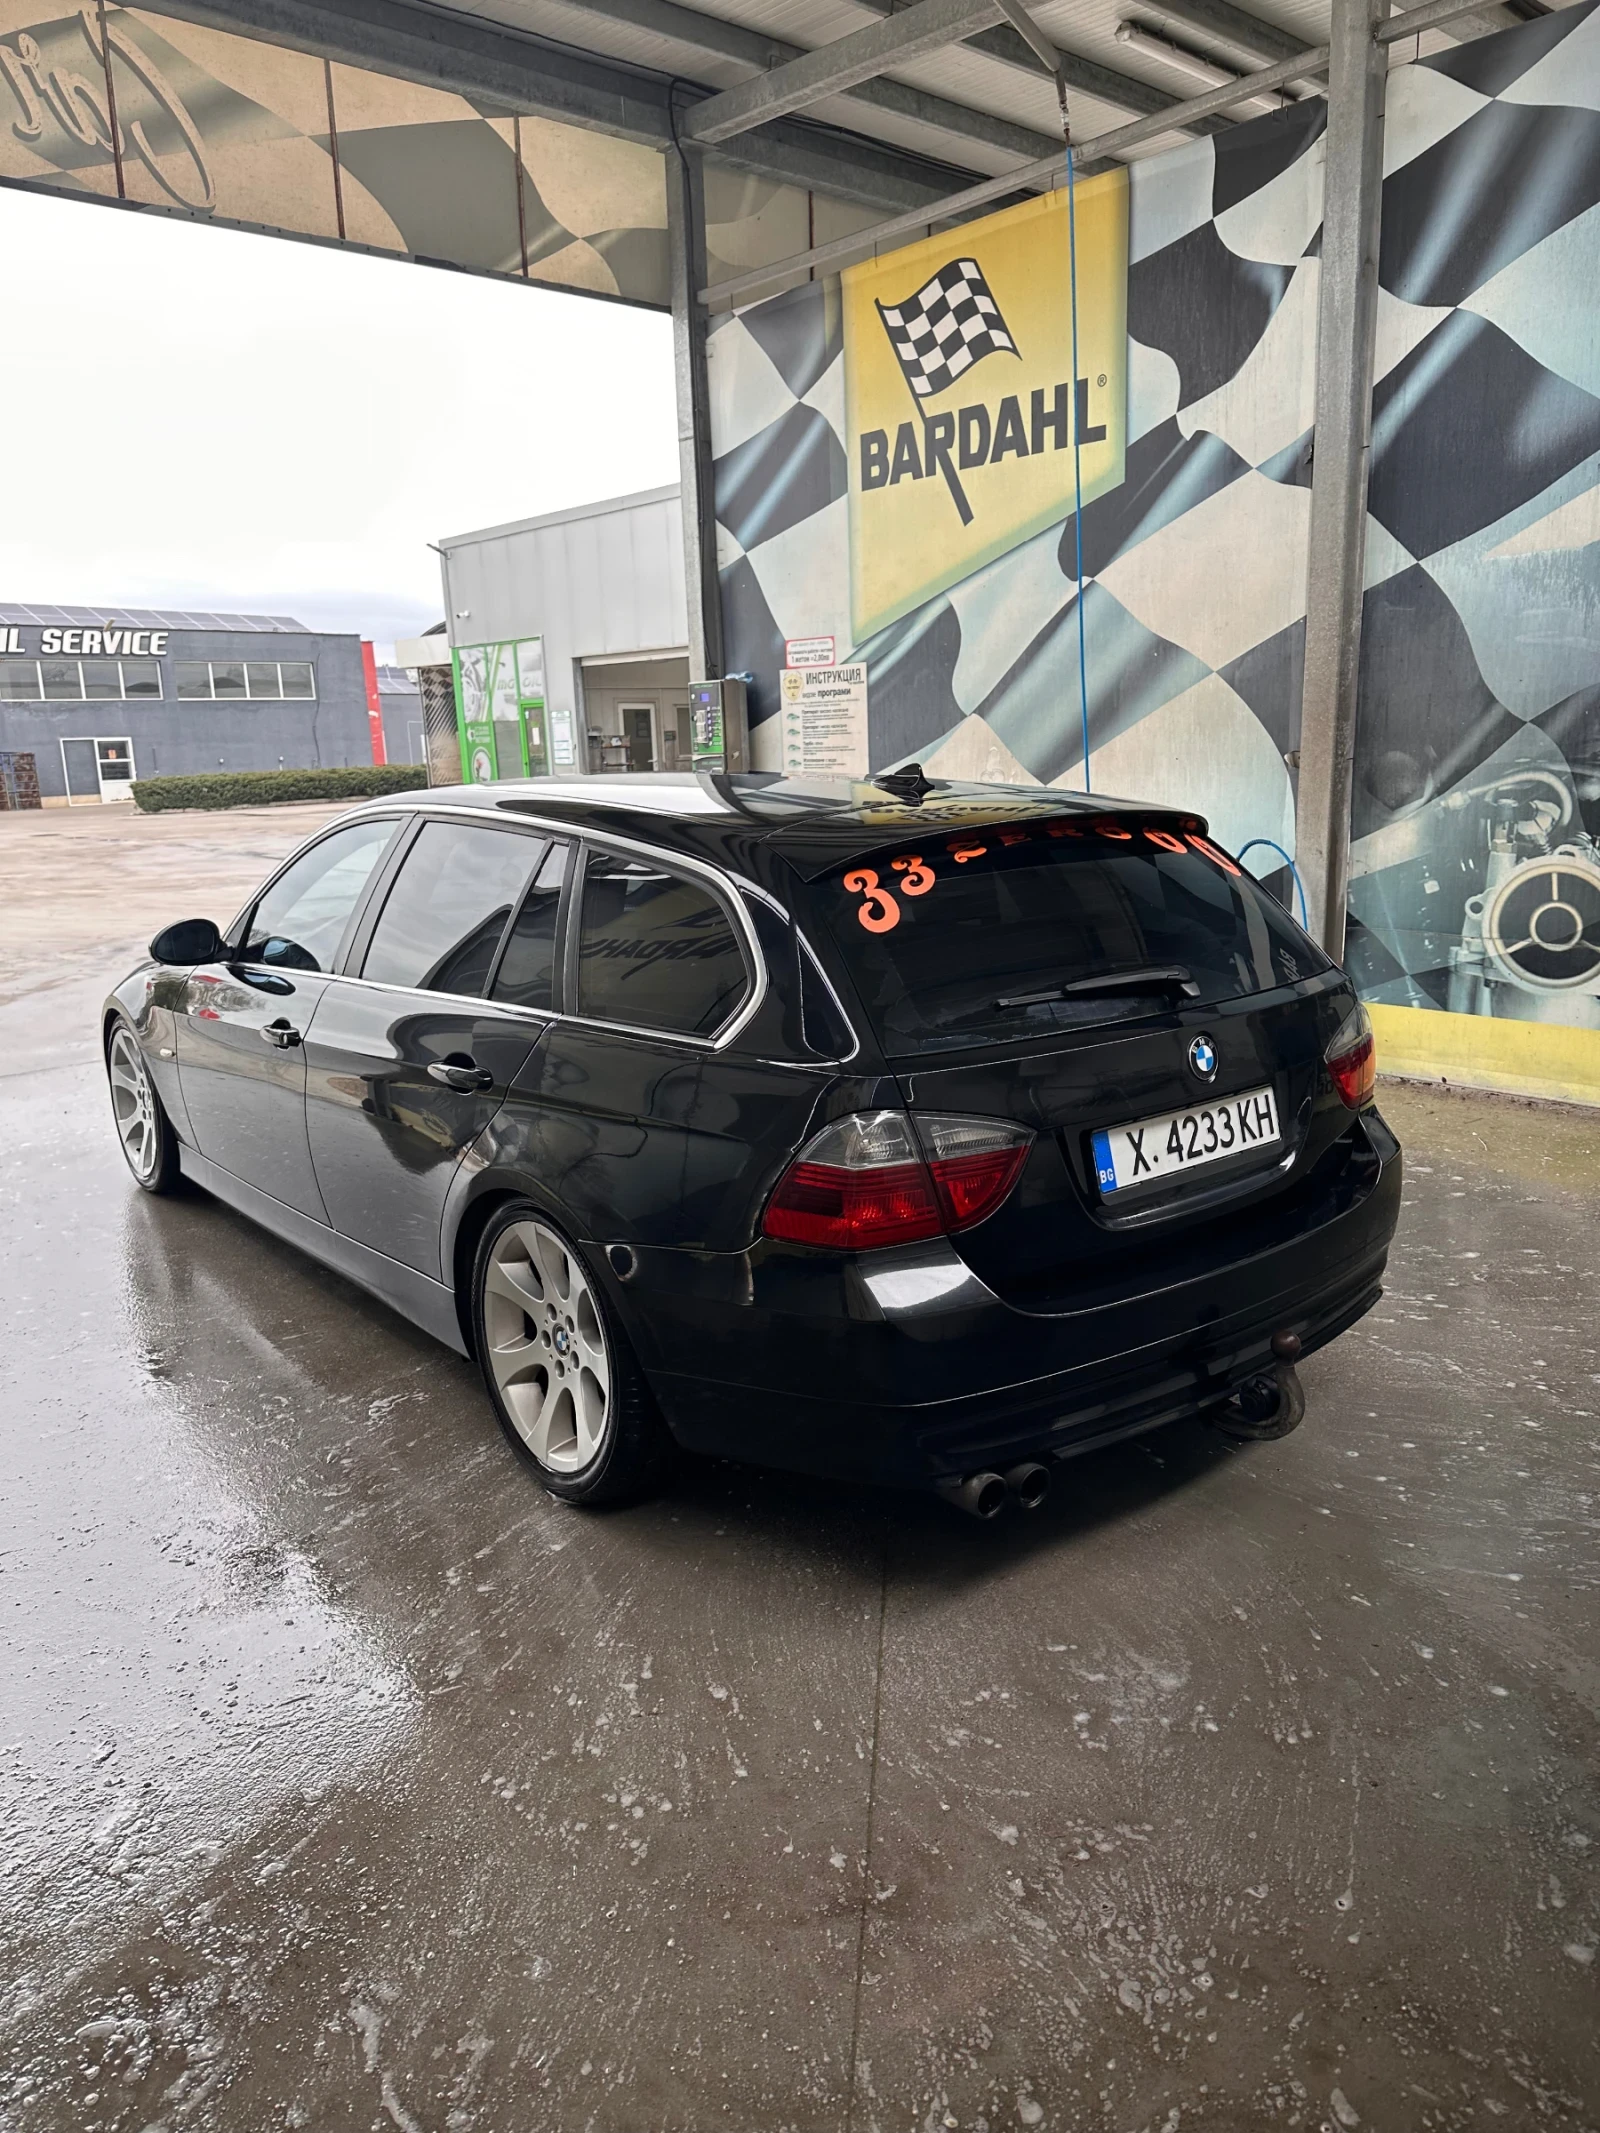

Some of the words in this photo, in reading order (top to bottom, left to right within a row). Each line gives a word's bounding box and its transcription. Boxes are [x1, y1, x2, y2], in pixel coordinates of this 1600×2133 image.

[860, 377, 1107, 527] BARDAHL
[41, 628, 169, 656] SERVICE
[805, 668, 861, 685] ИНСТРУКЦИЯ
[817, 688, 851, 699] програми
[1191, 1037, 1216, 1055] BMW
[1100, 1167, 1114, 1184] BG
